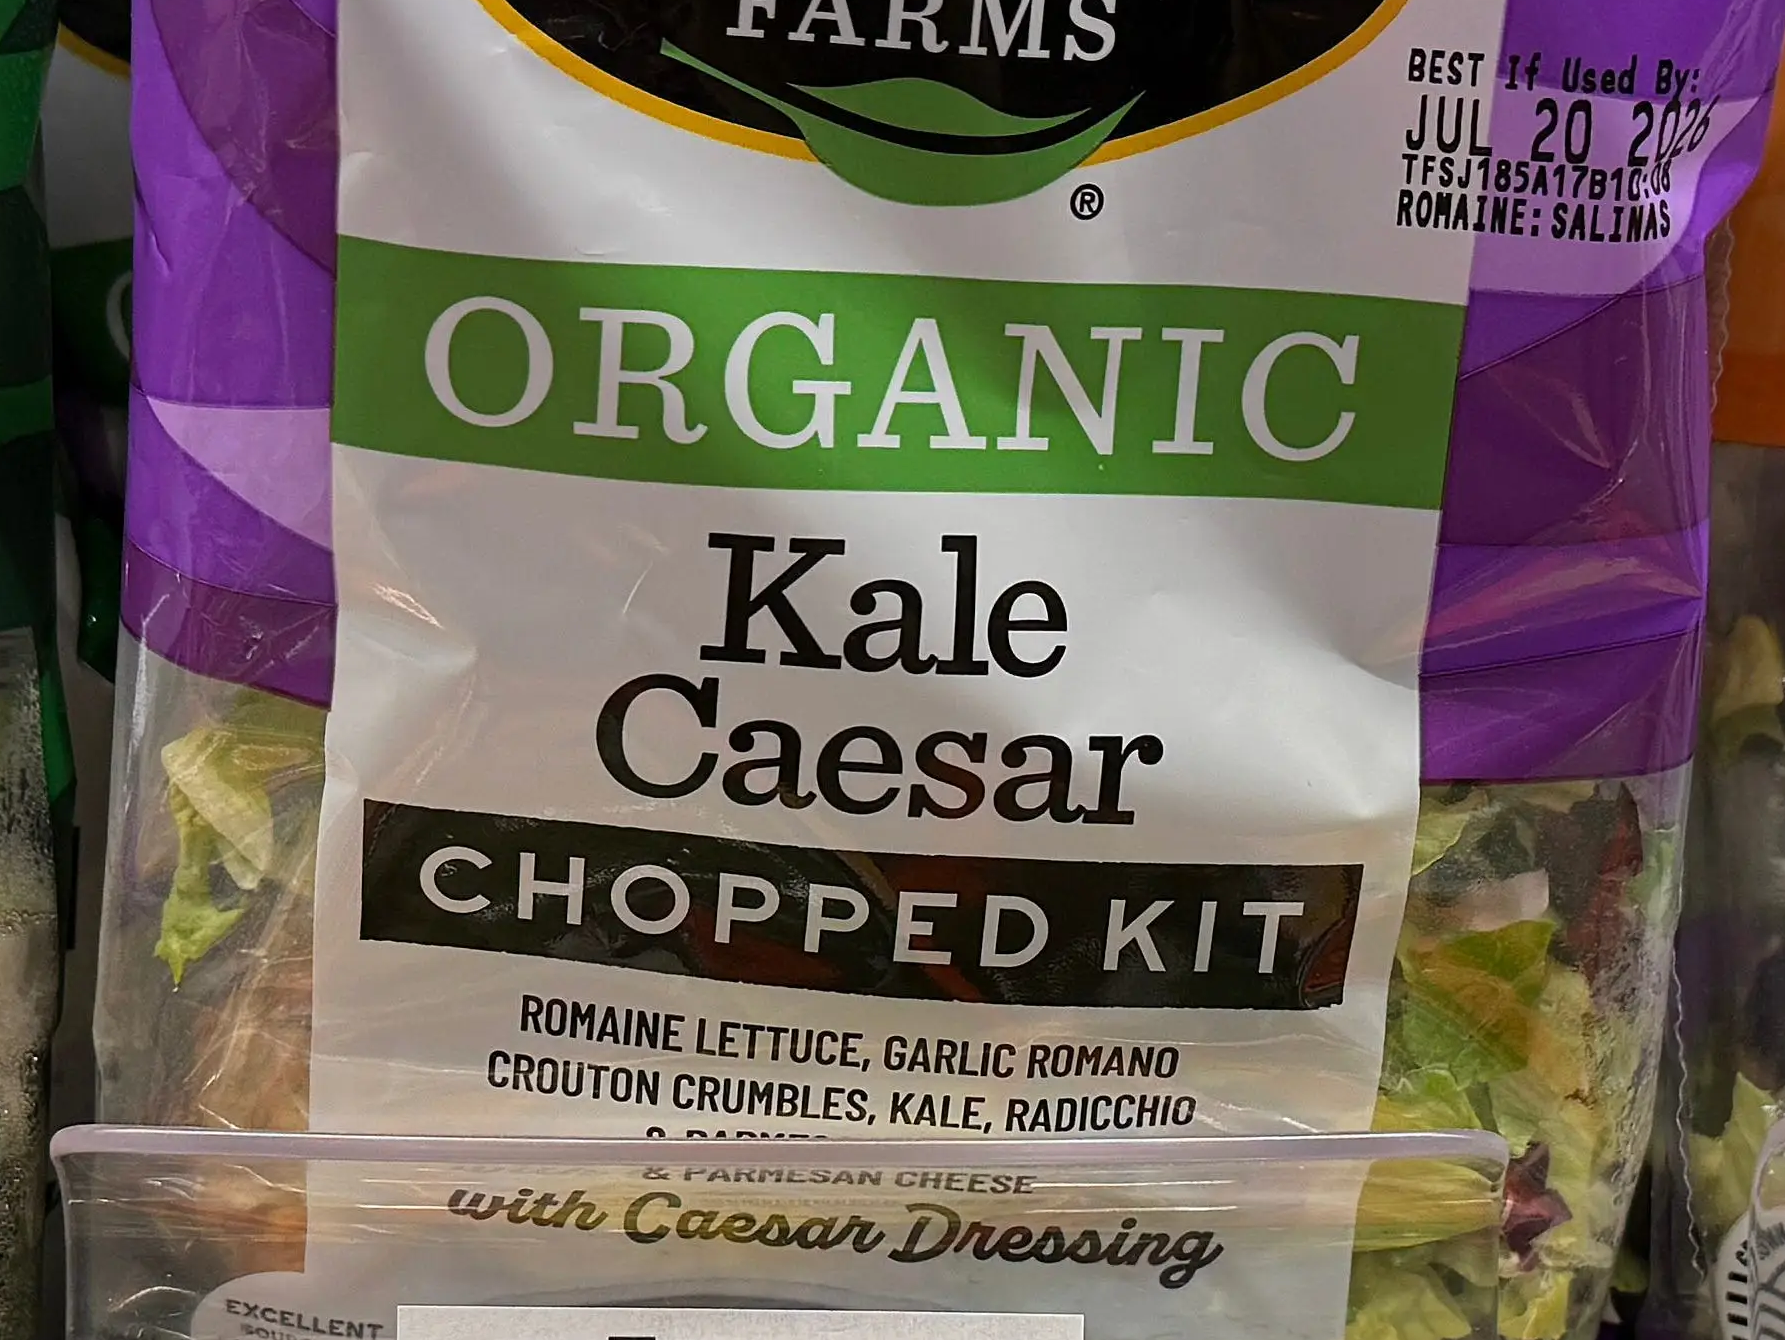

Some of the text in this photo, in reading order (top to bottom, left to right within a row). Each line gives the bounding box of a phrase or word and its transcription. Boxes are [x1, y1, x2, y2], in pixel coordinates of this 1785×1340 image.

[1408, 49, 1699, 97] BEST If Used By:
[1406, 93, 1493, 157] JUL
[1531, 98, 1592, 164] 20
[423, 295, 1364, 461] ORGANIC
[699, 531, 1067, 677] Kale
[594, 674, 1164, 827] Caesar
[419, 845, 1306, 975] CHOPPED KIT
[520, 994, 1180, 1080] ROMAINE LETTUCE, GARLIC ROMANO
[487, 1050, 1194, 1133] CROUTON CRUMBLES, KALE, RADICCHIO
[446, 1188, 1223, 1288] with Caesar Dressing
